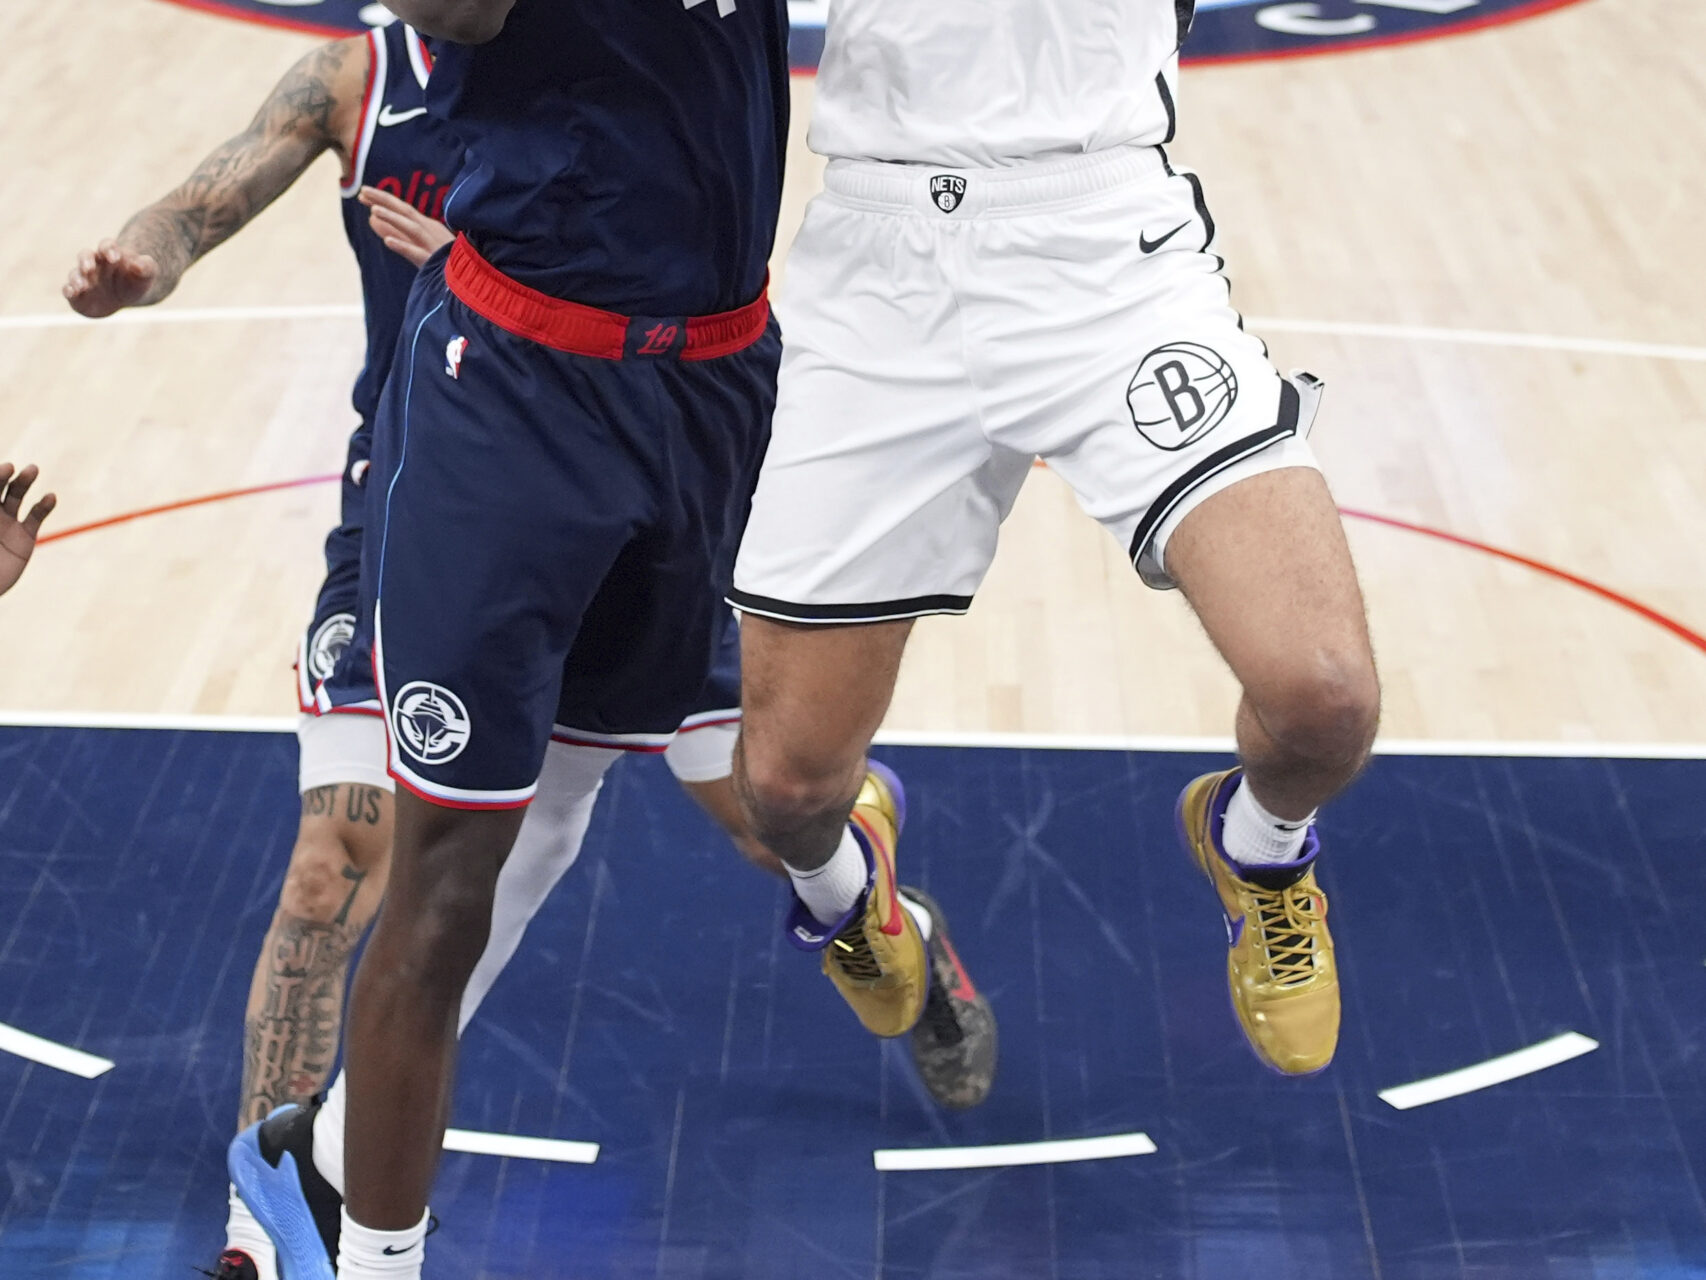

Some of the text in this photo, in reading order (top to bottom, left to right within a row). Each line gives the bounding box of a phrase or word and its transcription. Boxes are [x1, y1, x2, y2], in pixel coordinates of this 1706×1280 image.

[931, 176, 965, 194] NETS
[636, 322, 678, 355] LA
[1153, 360, 1206, 433] B
[346, 786, 382, 826] US
